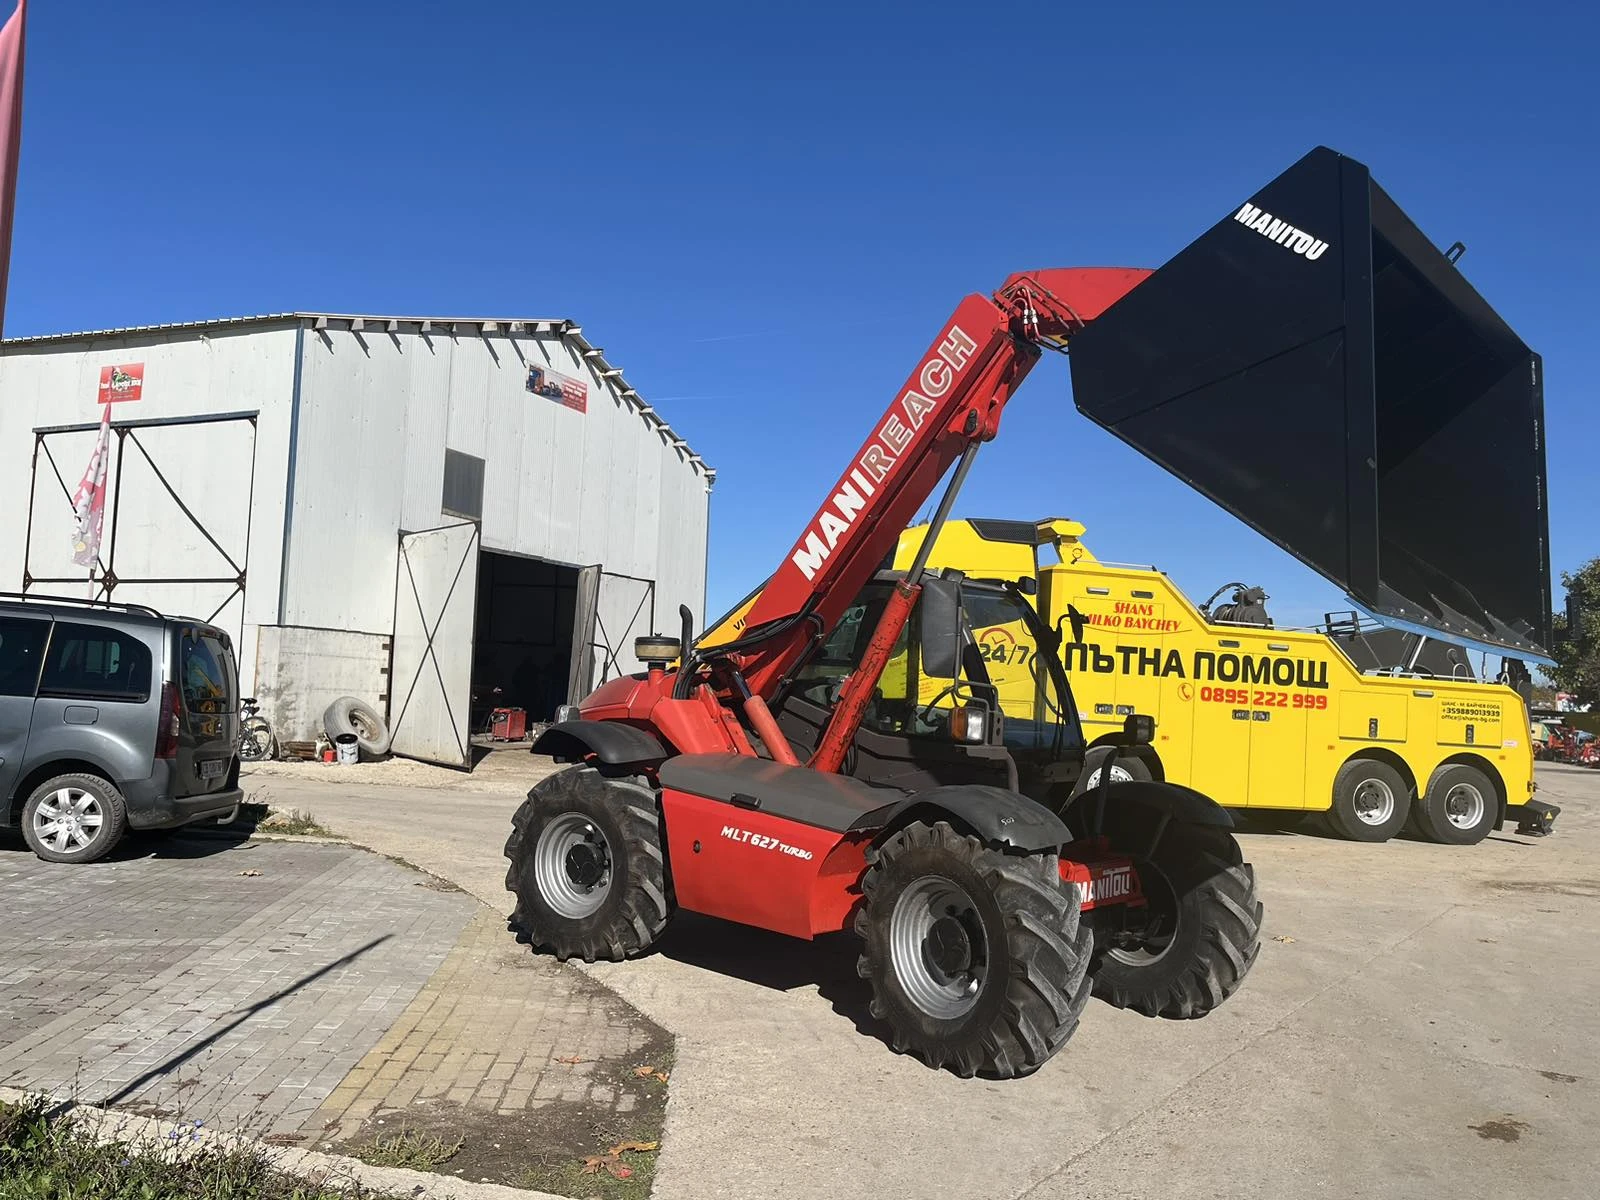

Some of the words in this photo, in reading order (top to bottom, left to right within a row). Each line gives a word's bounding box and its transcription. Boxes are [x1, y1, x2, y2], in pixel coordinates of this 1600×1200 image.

[1234, 202, 1330, 261] MANITOU
[1113, 602, 1154, 616] SHANS
[1124, 616, 1181, 632] BAYCHEV
[980, 643, 1030, 665] 24/7
[1065, 642, 1186, 679] ПЪТНА
[1193, 651, 1329, 690] ПОМОЩ
[1200, 686, 1249, 705] 0895
[1253, 690, 1288, 708] 222
[1292, 693, 1328, 710] 999
[779, 842, 813, 860] TURBO
